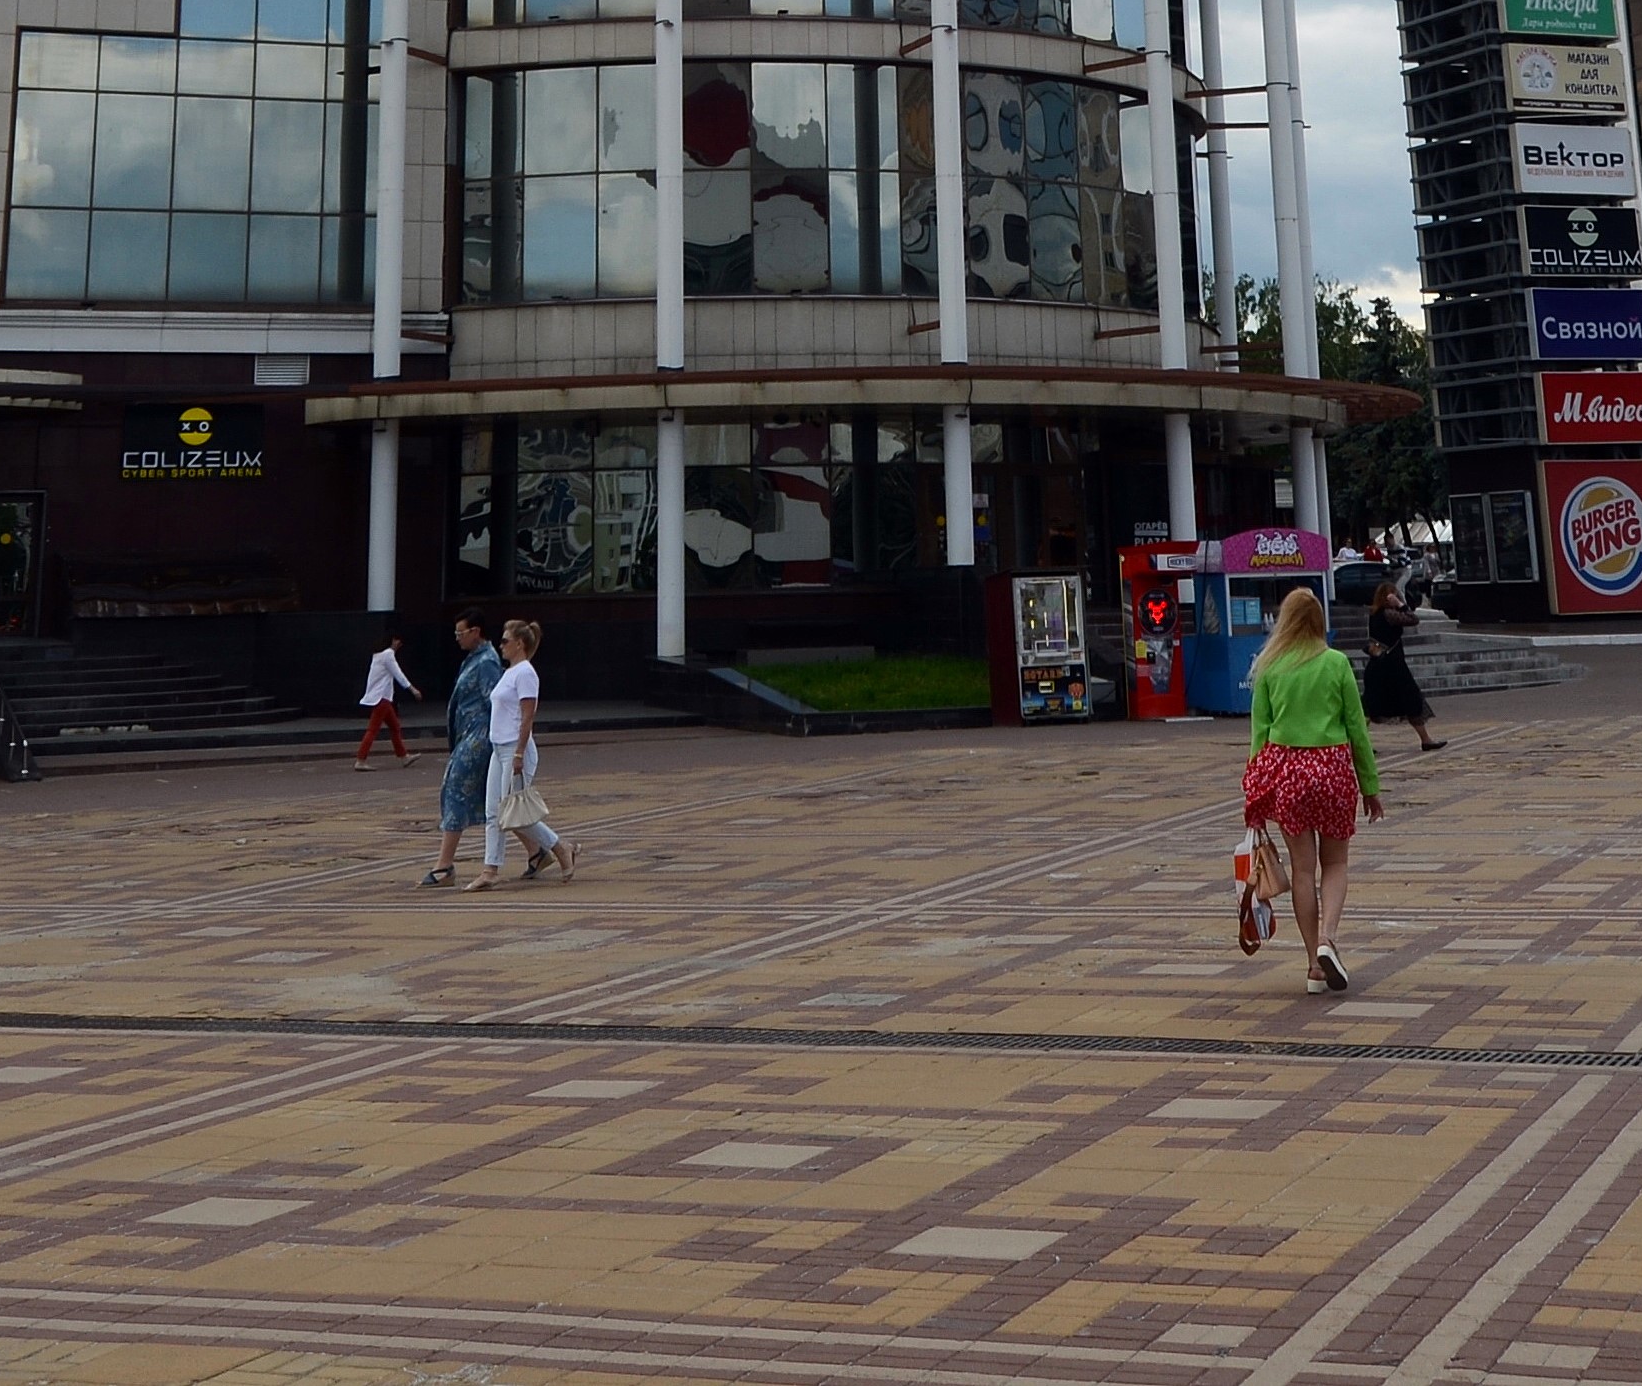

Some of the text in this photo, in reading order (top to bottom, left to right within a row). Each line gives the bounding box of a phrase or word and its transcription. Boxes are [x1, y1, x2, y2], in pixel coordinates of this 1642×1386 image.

[1566, 52, 1610, 66] МАГАЗИН
[1580, 69, 1599, 80] ДЛЯ
[1564, 83, 1619, 96] КОНДИТЕРА
[1529, 249, 1642, 266] COLIZEUM
[1541, 316, 1642, 339] Связной
[122, 451, 262, 468] COLIZEUM
[122, 468, 263, 479] CYBER SPORT ARENA
[1134, 520, 1168, 531] ОГАРЁВ
[1571, 499, 1637, 541] BURGER
[1576, 518, 1642, 569] KING
